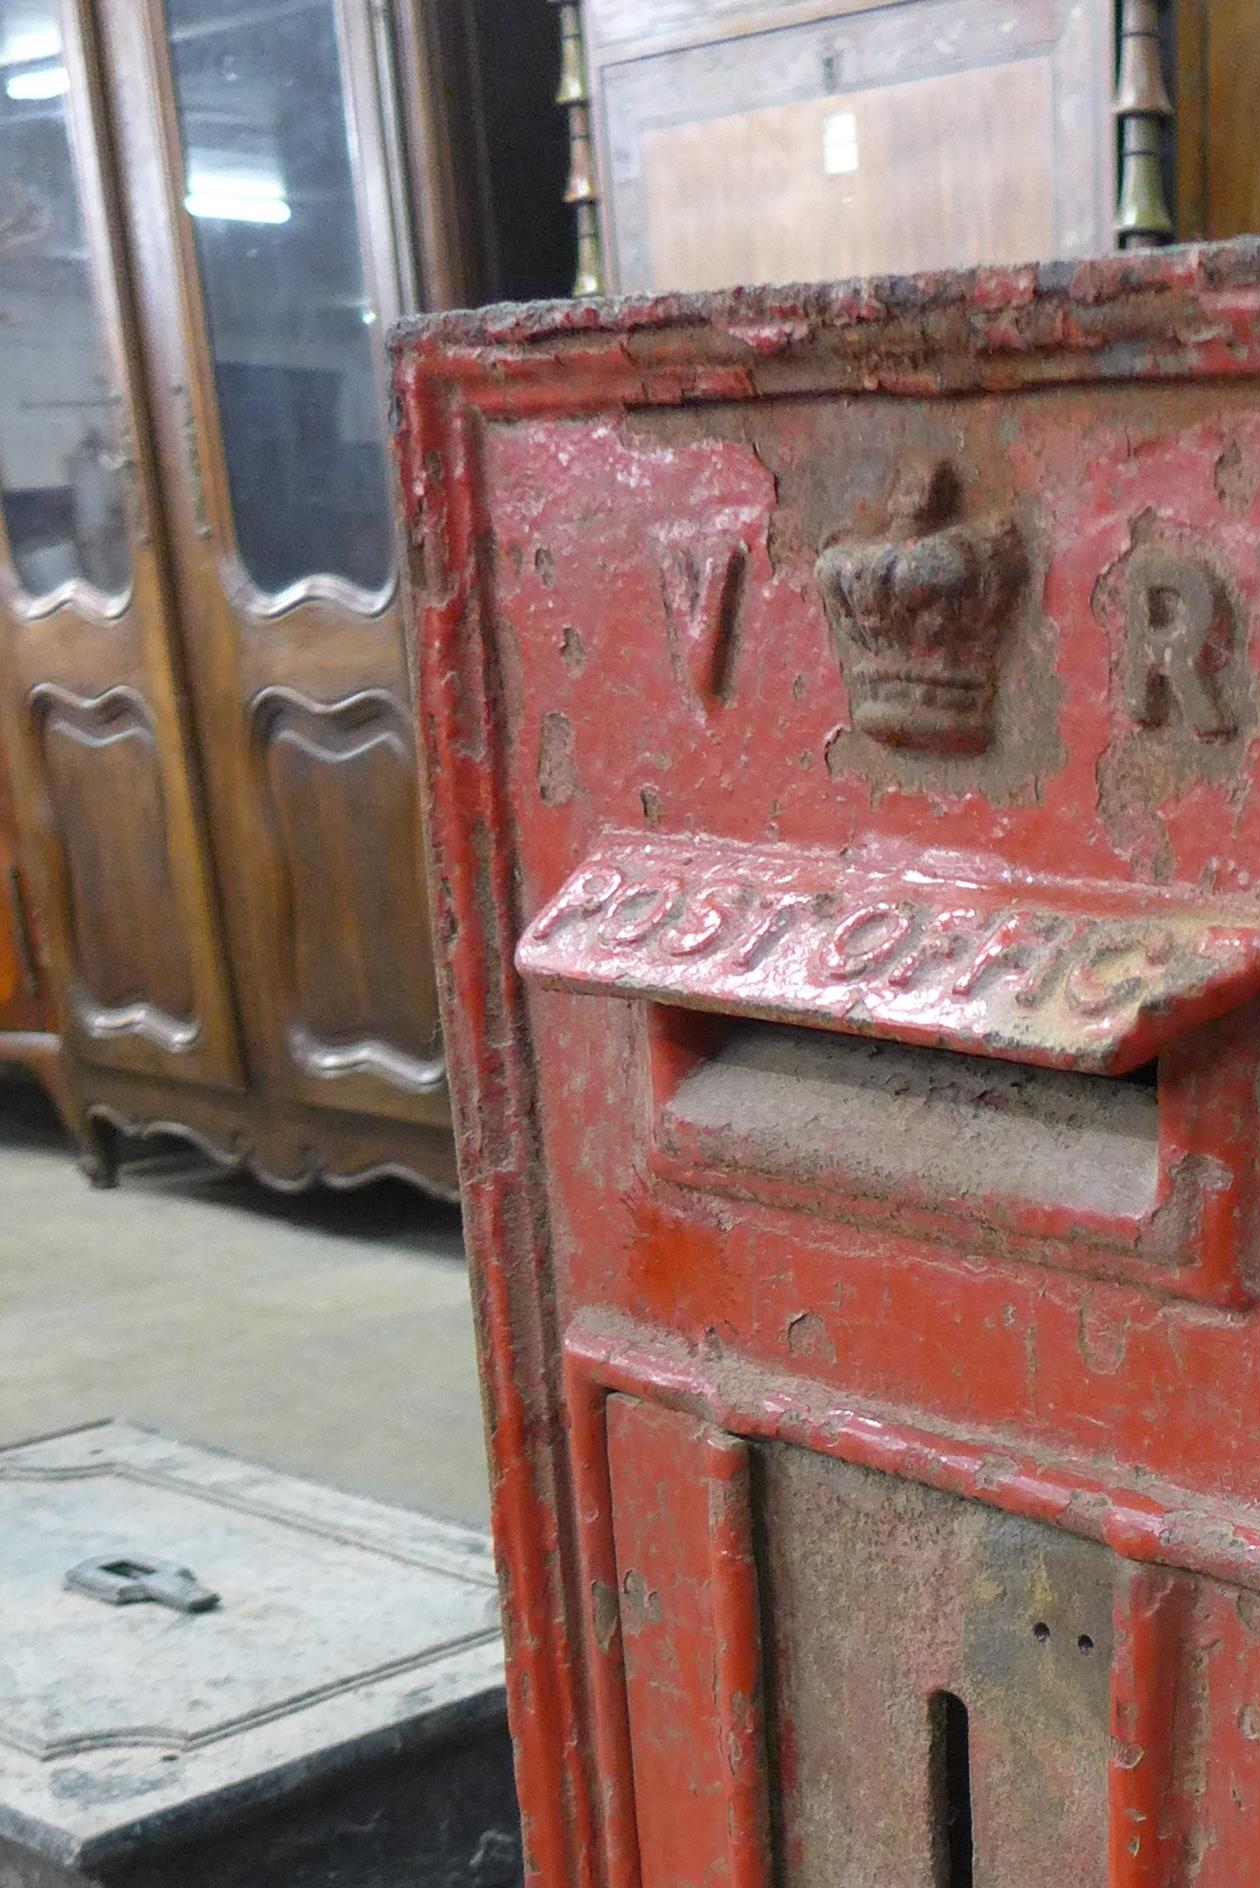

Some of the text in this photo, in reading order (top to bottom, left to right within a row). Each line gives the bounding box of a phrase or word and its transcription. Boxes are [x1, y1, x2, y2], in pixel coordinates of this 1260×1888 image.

[649, 506, 1239, 745] V R
[530, 861, 1256, 1018] POST OFFIC
